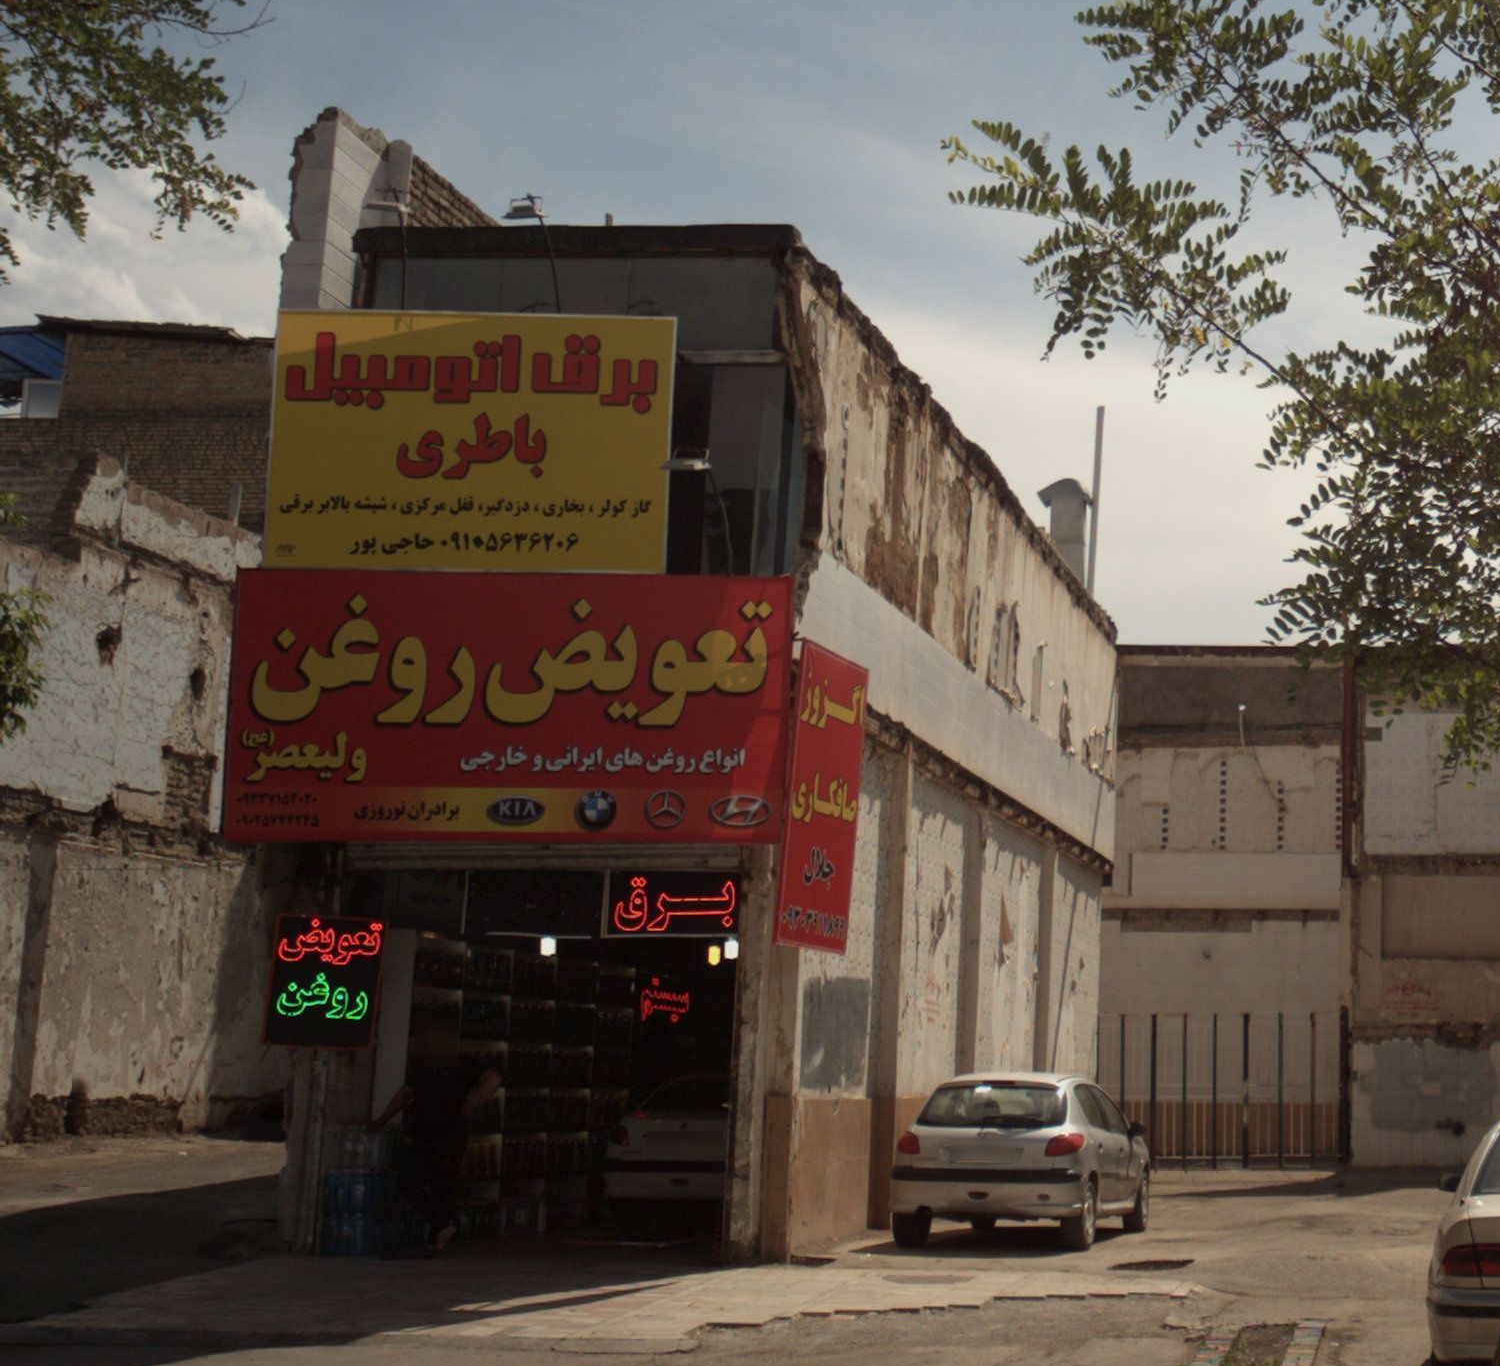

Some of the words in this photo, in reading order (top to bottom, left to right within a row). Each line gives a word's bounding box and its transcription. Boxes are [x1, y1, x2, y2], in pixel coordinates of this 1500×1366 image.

[284, 331, 521, 409] اتومبیل
[531, 334, 659, 414] برق
[396, 412, 548, 479] باطری
[279, 496, 314, 515] برقی
[354, 495, 388, 512] شیشه
[401, 496, 445, 515] مرکزی
[448, 497, 474, 516] قفل
[543, 498, 585, 517] بخاری
[598, 498, 627, 518] کولر
[630, 499, 652, 519] گاز
[350, 536, 377, 556] پور
[382, 532, 433, 554] حاجی
[251, 592, 475, 726] روغن
[484, 598, 773, 727] تعویض
[801, 671, 864, 729] اگزوز
[246, 730, 368, 781] ولیعصر
[460, 745, 528, 772] خارجی
[532, 753, 541, 771] و
[545, 747, 603, 773] ایرانی
[604, 747, 643, 773] های
[645, 747, 696, 774] روغن
[699, 747, 745, 774] انواع
[354, 801, 405, 821] نوروزی
[407, 801, 459, 821] برادران
[499, 801, 537, 817] KIA
[791, 772, 857, 824] صافکاری
[803, 846, 835, 890] جلال
[613, 875, 737, 933] برق
[277, 917, 384, 966] تعویض
[276, 969, 369, 1021] روغن
